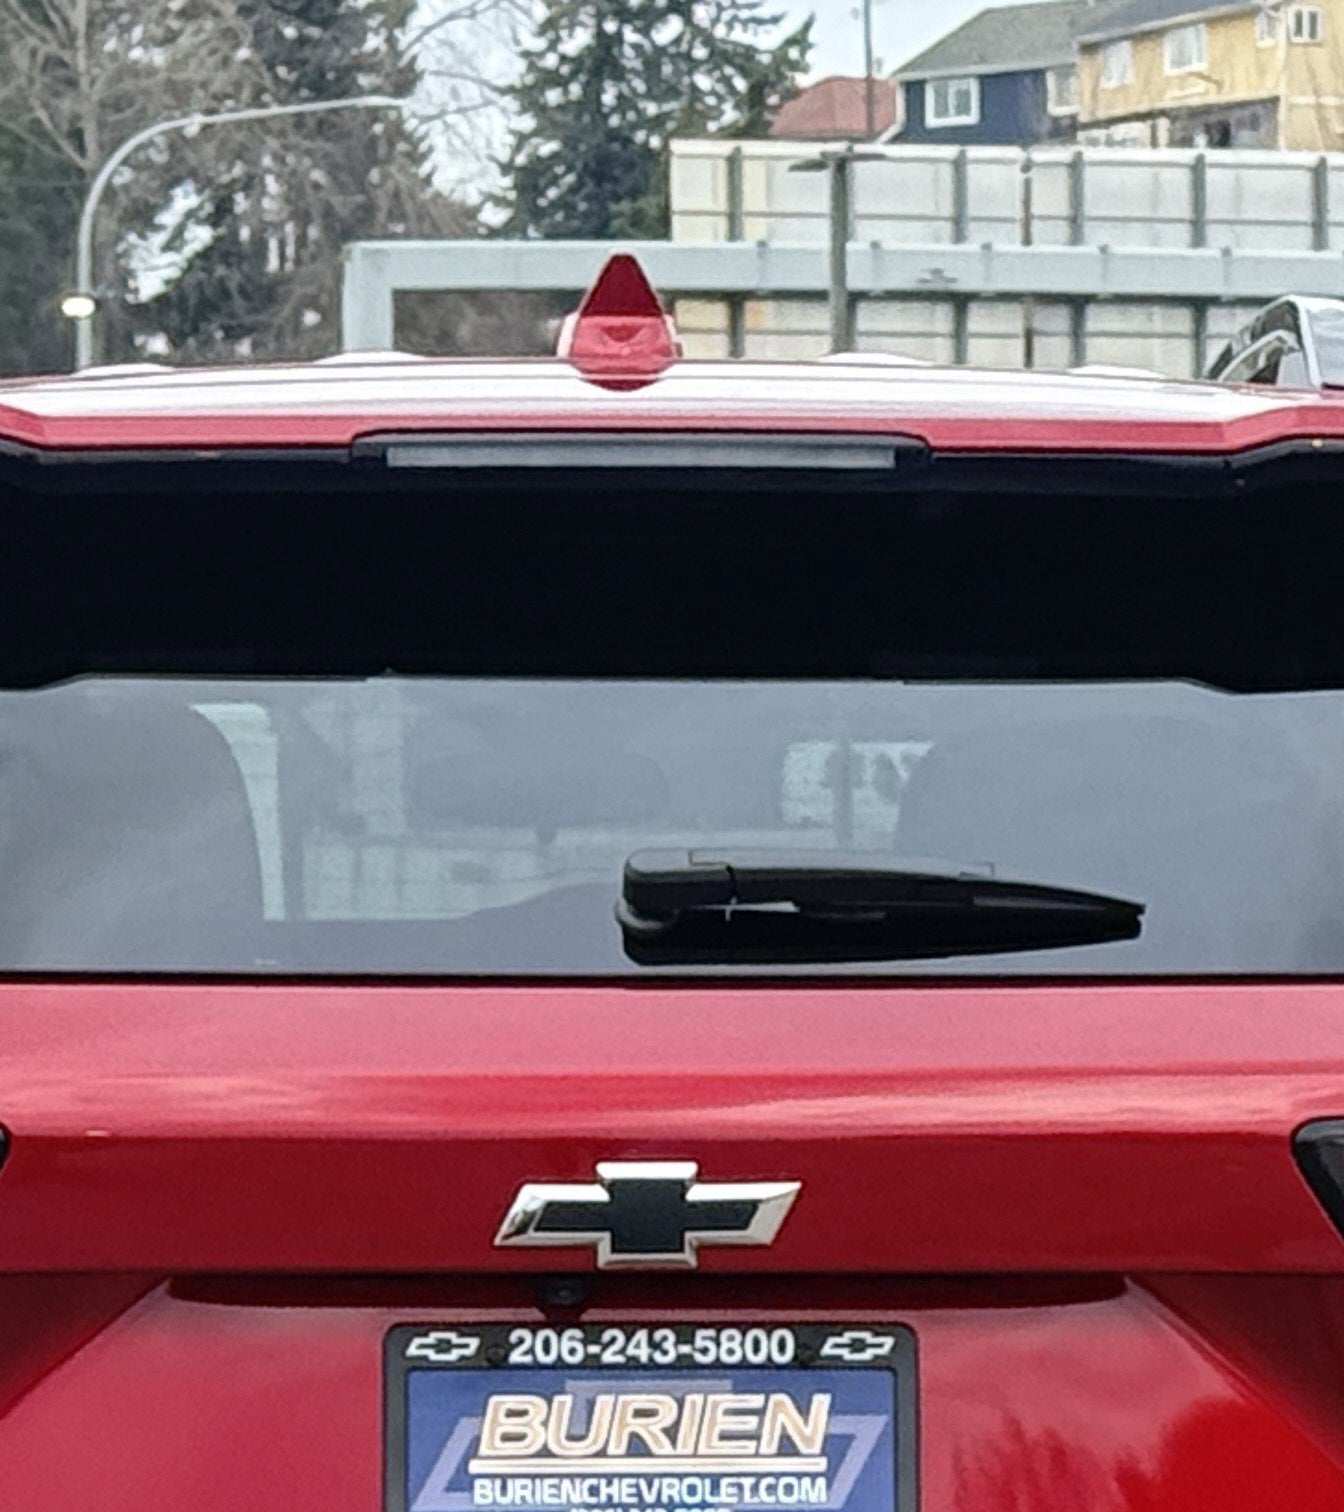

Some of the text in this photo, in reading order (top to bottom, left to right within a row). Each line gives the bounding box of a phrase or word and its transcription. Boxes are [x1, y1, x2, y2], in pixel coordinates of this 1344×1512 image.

[507, 1328, 796, 1364] 206-243-5800
[477, 1392, 832, 1458] BURIEN
[473, 1477, 828, 1506] BURIENCHEVROLET.COM
